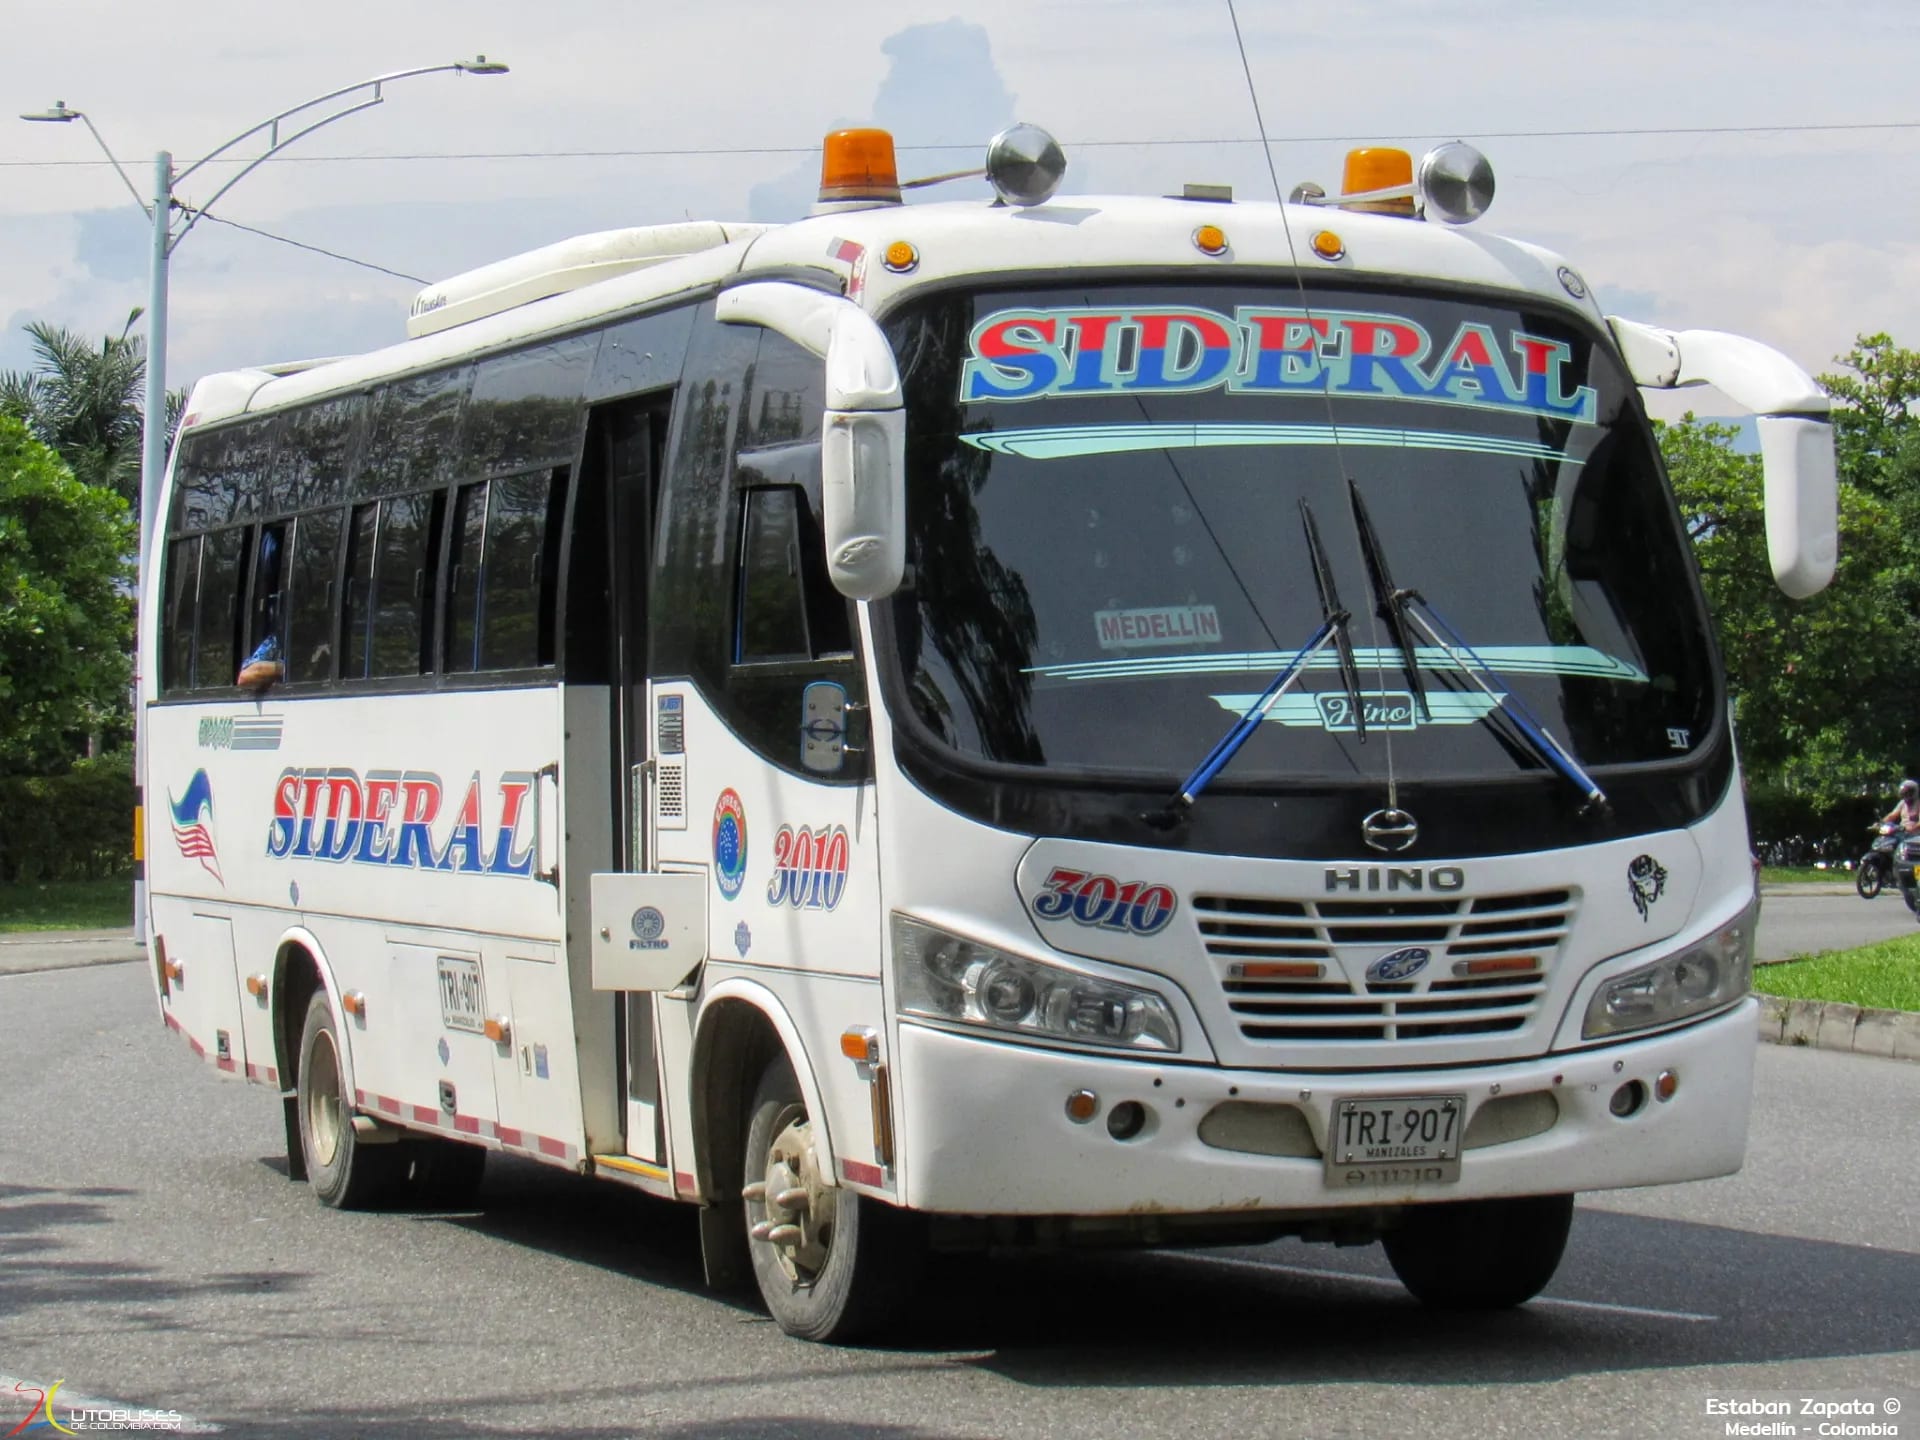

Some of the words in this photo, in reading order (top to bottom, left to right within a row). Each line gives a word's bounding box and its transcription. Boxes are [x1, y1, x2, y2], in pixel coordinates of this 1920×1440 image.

[960, 305, 1597, 425] SIDERAL
[1327, 699, 1411, 725] Hino
[265, 767, 539, 879] SIDERAL
[767, 823, 850, 912] 3010
[1325, 866, 1466, 893] HINO
[1033, 866, 1178, 935] 3010
[629, 939, 669, 950] FILTRO
[1366, 1146, 1427, 1158] MANIZALES
